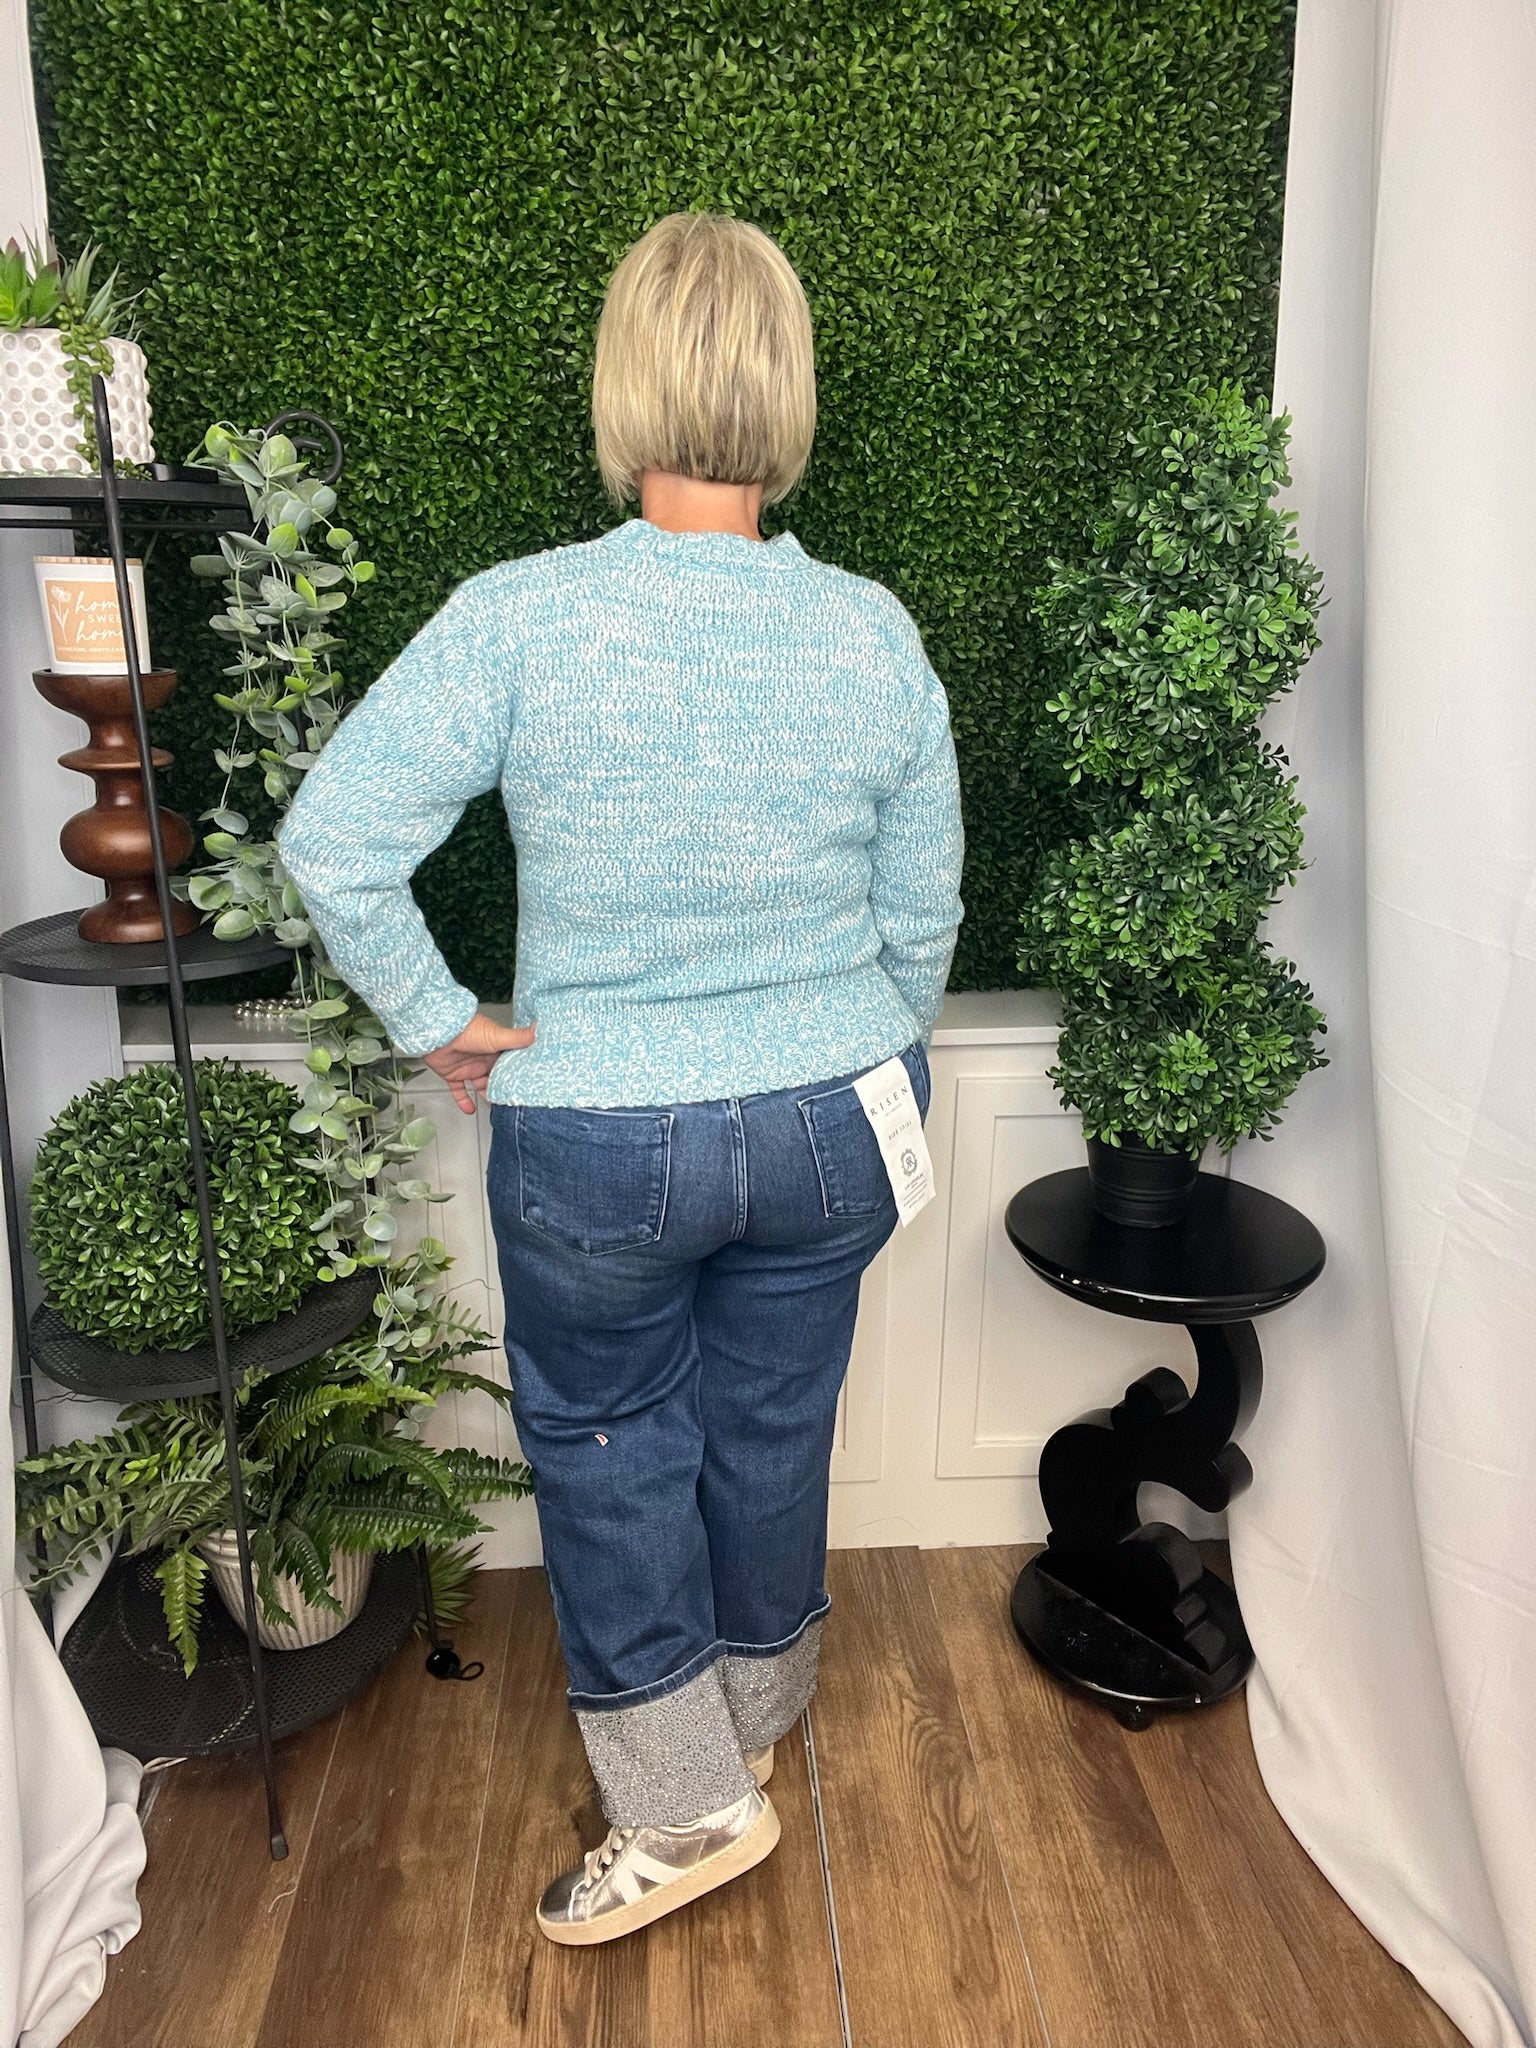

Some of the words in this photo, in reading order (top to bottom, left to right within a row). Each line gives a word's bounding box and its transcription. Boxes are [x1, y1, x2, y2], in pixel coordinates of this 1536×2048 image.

[75, 590, 119, 615] hom
[88, 614, 121, 624] SWEE
[870, 1085, 908, 1117] RISEN
